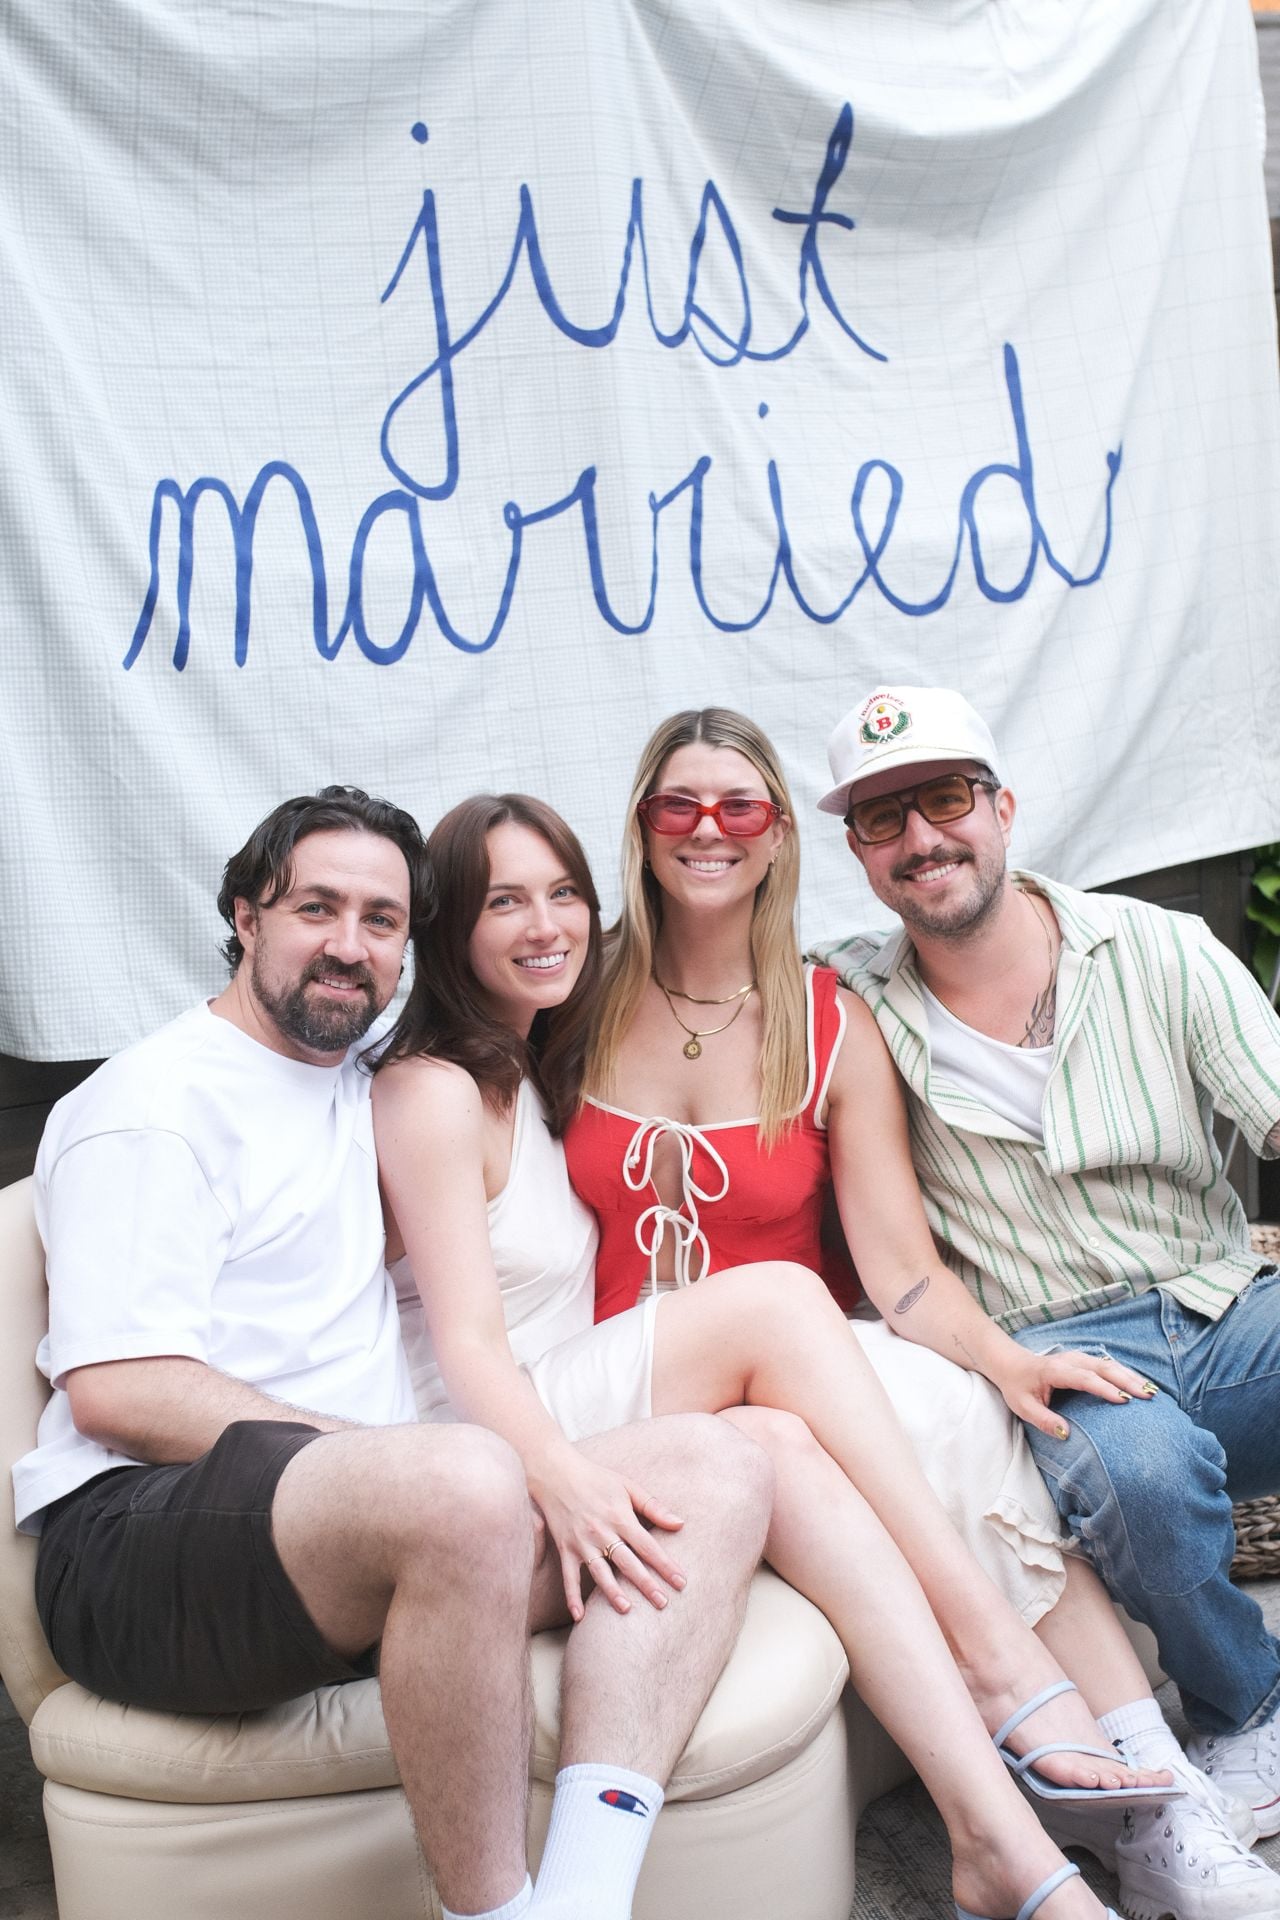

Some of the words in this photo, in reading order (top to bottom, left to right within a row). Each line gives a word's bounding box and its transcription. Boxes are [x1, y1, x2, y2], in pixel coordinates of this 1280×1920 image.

[380, 102, 887, 500] just
[123, 342, 1122, 671] married
[876, 716, 892, 732] B
